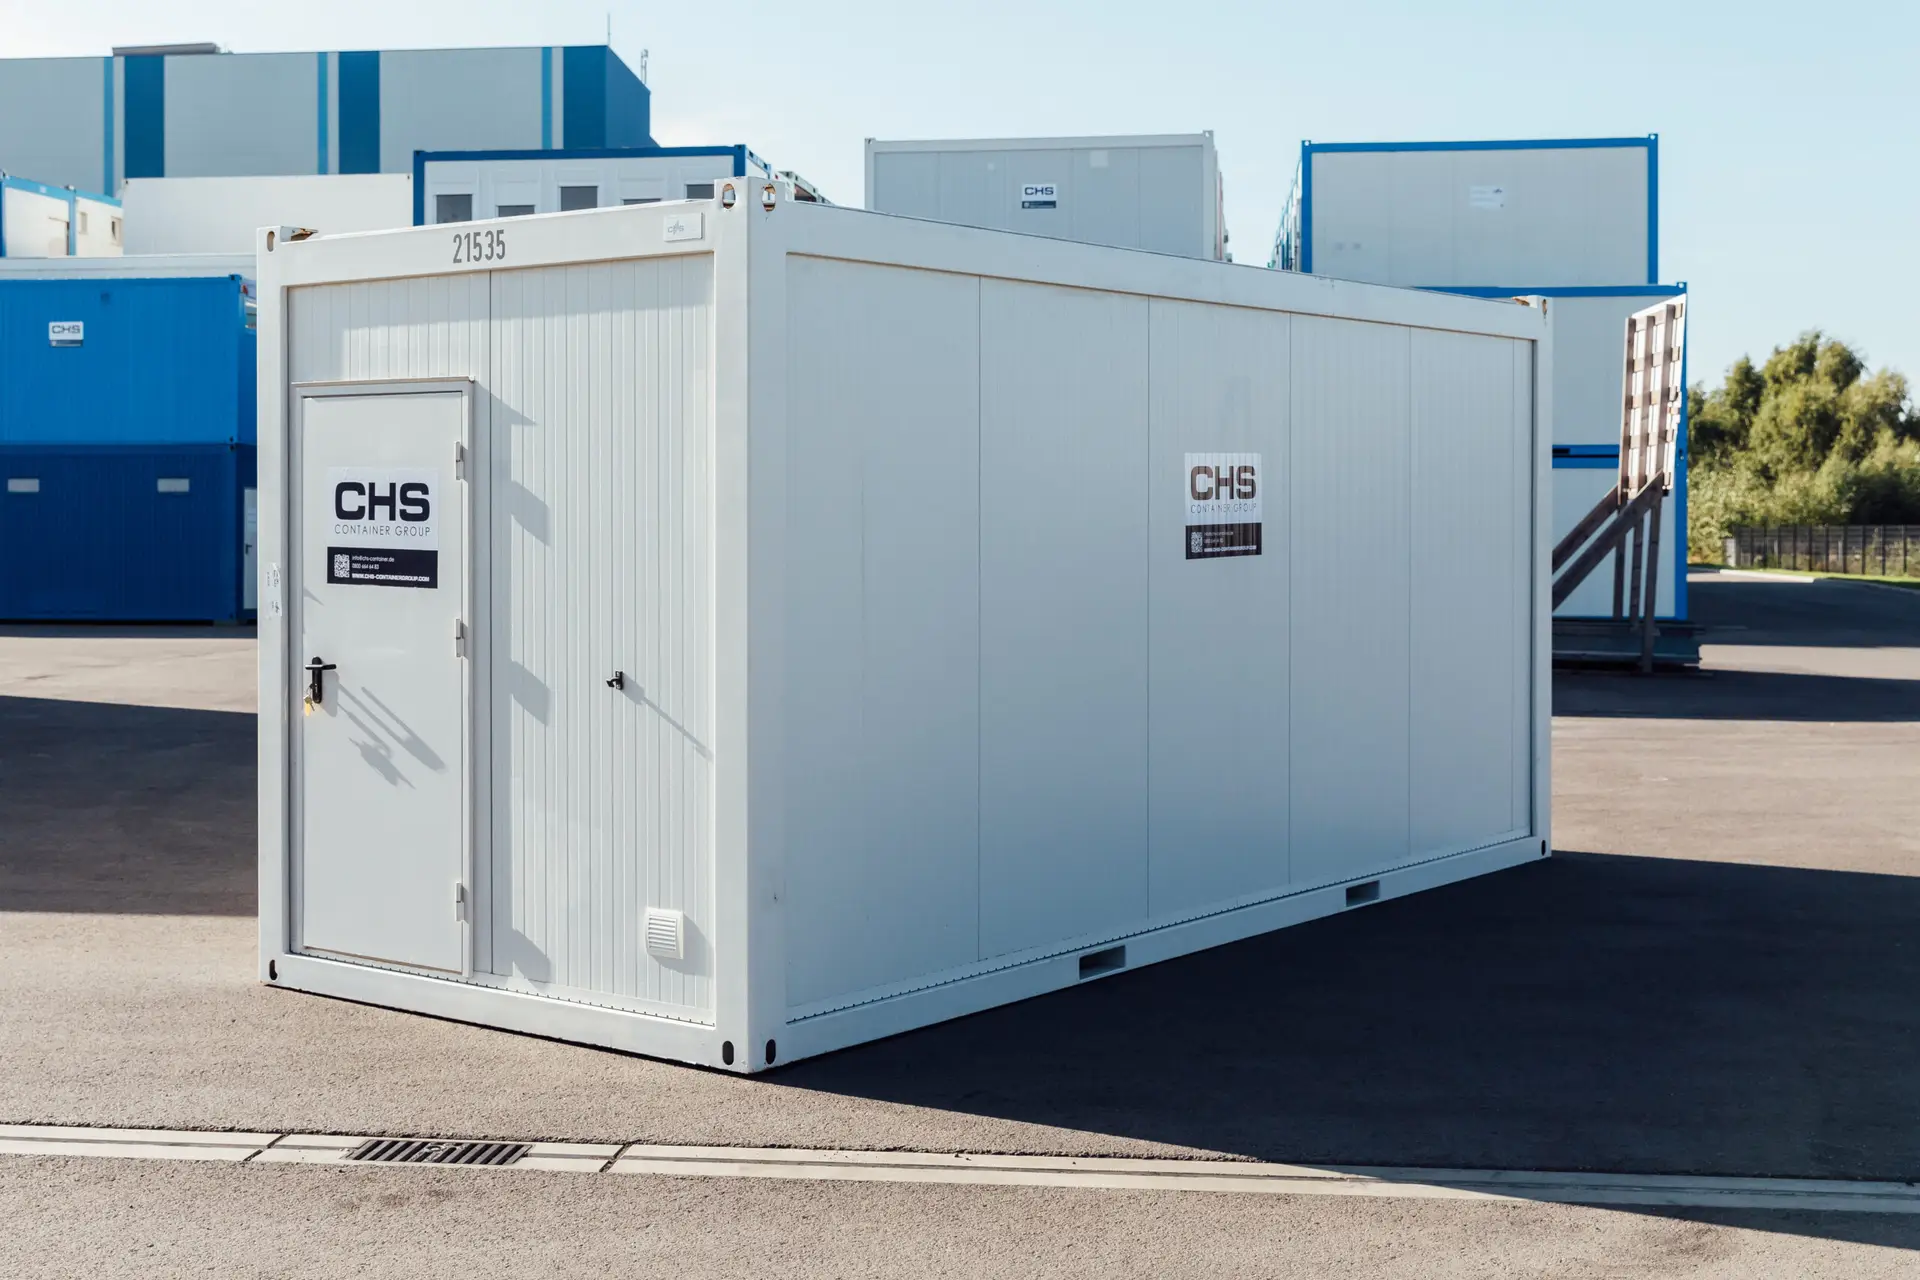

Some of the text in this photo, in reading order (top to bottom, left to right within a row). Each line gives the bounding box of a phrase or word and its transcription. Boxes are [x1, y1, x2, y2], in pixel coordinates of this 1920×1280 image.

[1024, 187, 1054, 195] CHS
[453, 229, 506, 264] 21535
[52, 324, 80, 334] CHS
[1190, 465, 1256, 500] CHS
[335, 481, 430, 522] CHS
[1190, 502, 1257, 513] CONTAINER GROUP
[334, 524, 431, 537] CONTAINER GROUP
